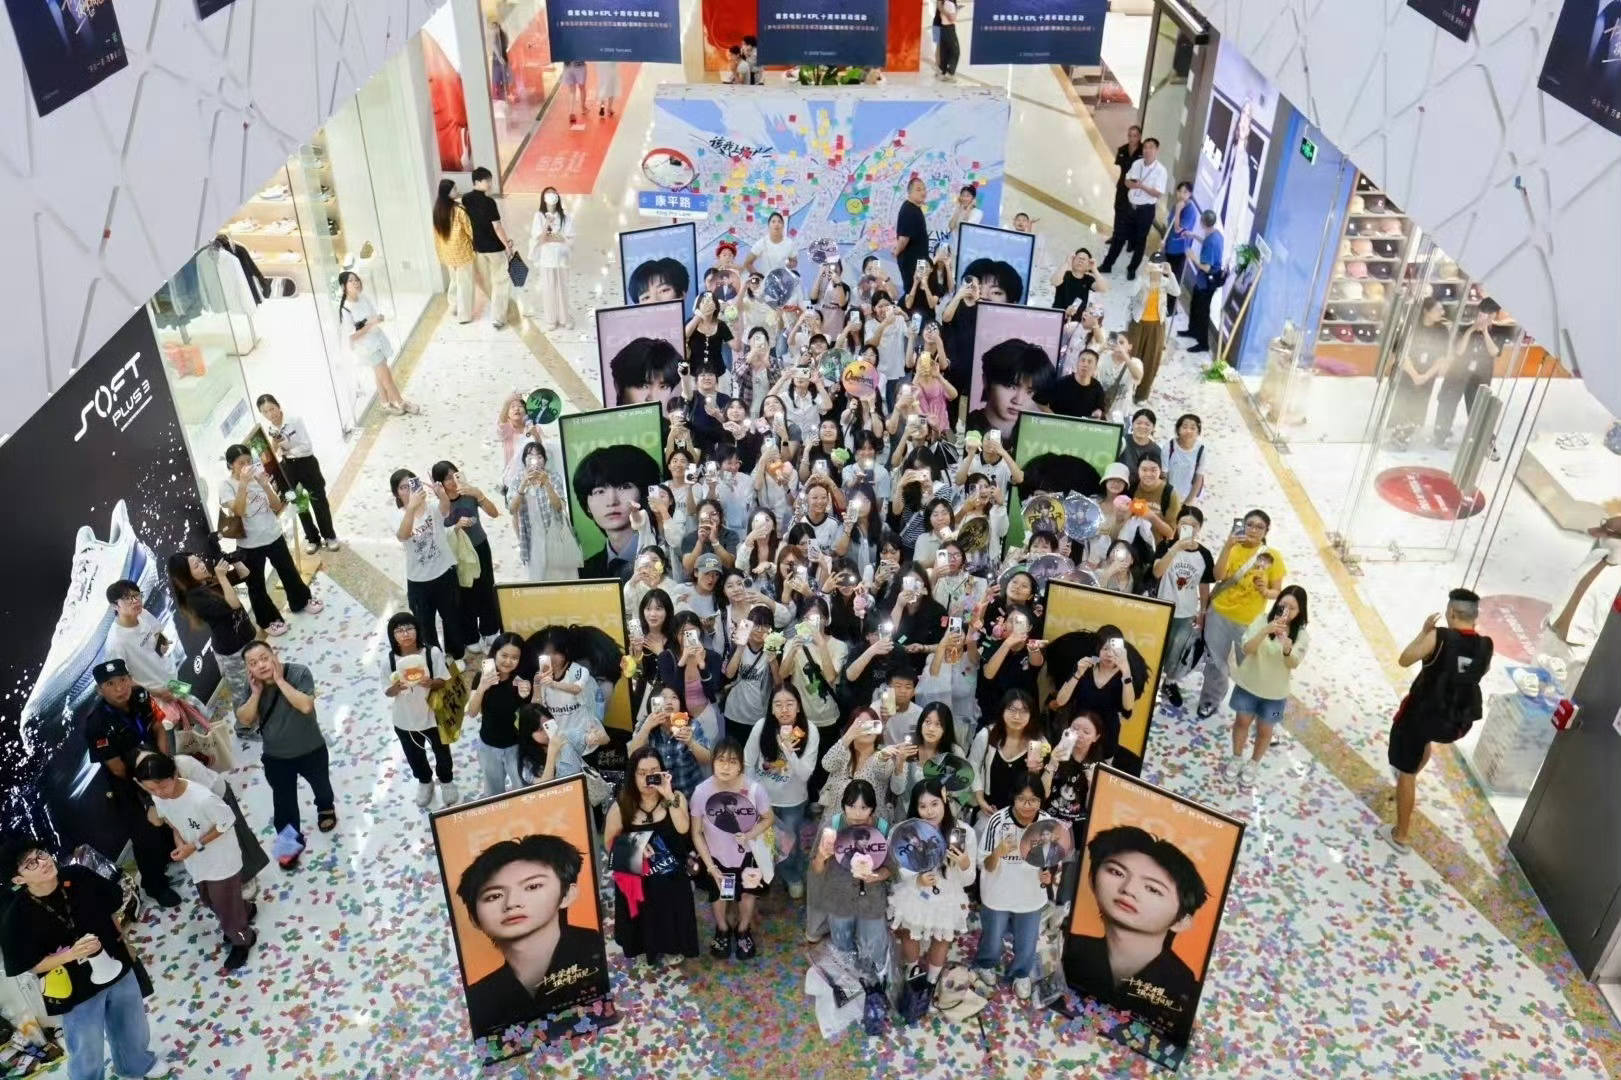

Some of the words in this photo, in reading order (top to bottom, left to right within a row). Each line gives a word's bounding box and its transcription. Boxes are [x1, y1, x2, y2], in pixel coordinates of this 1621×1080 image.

[655, 195, 691, 208] 康平路
[74, 351, 141, 442] SOFT
